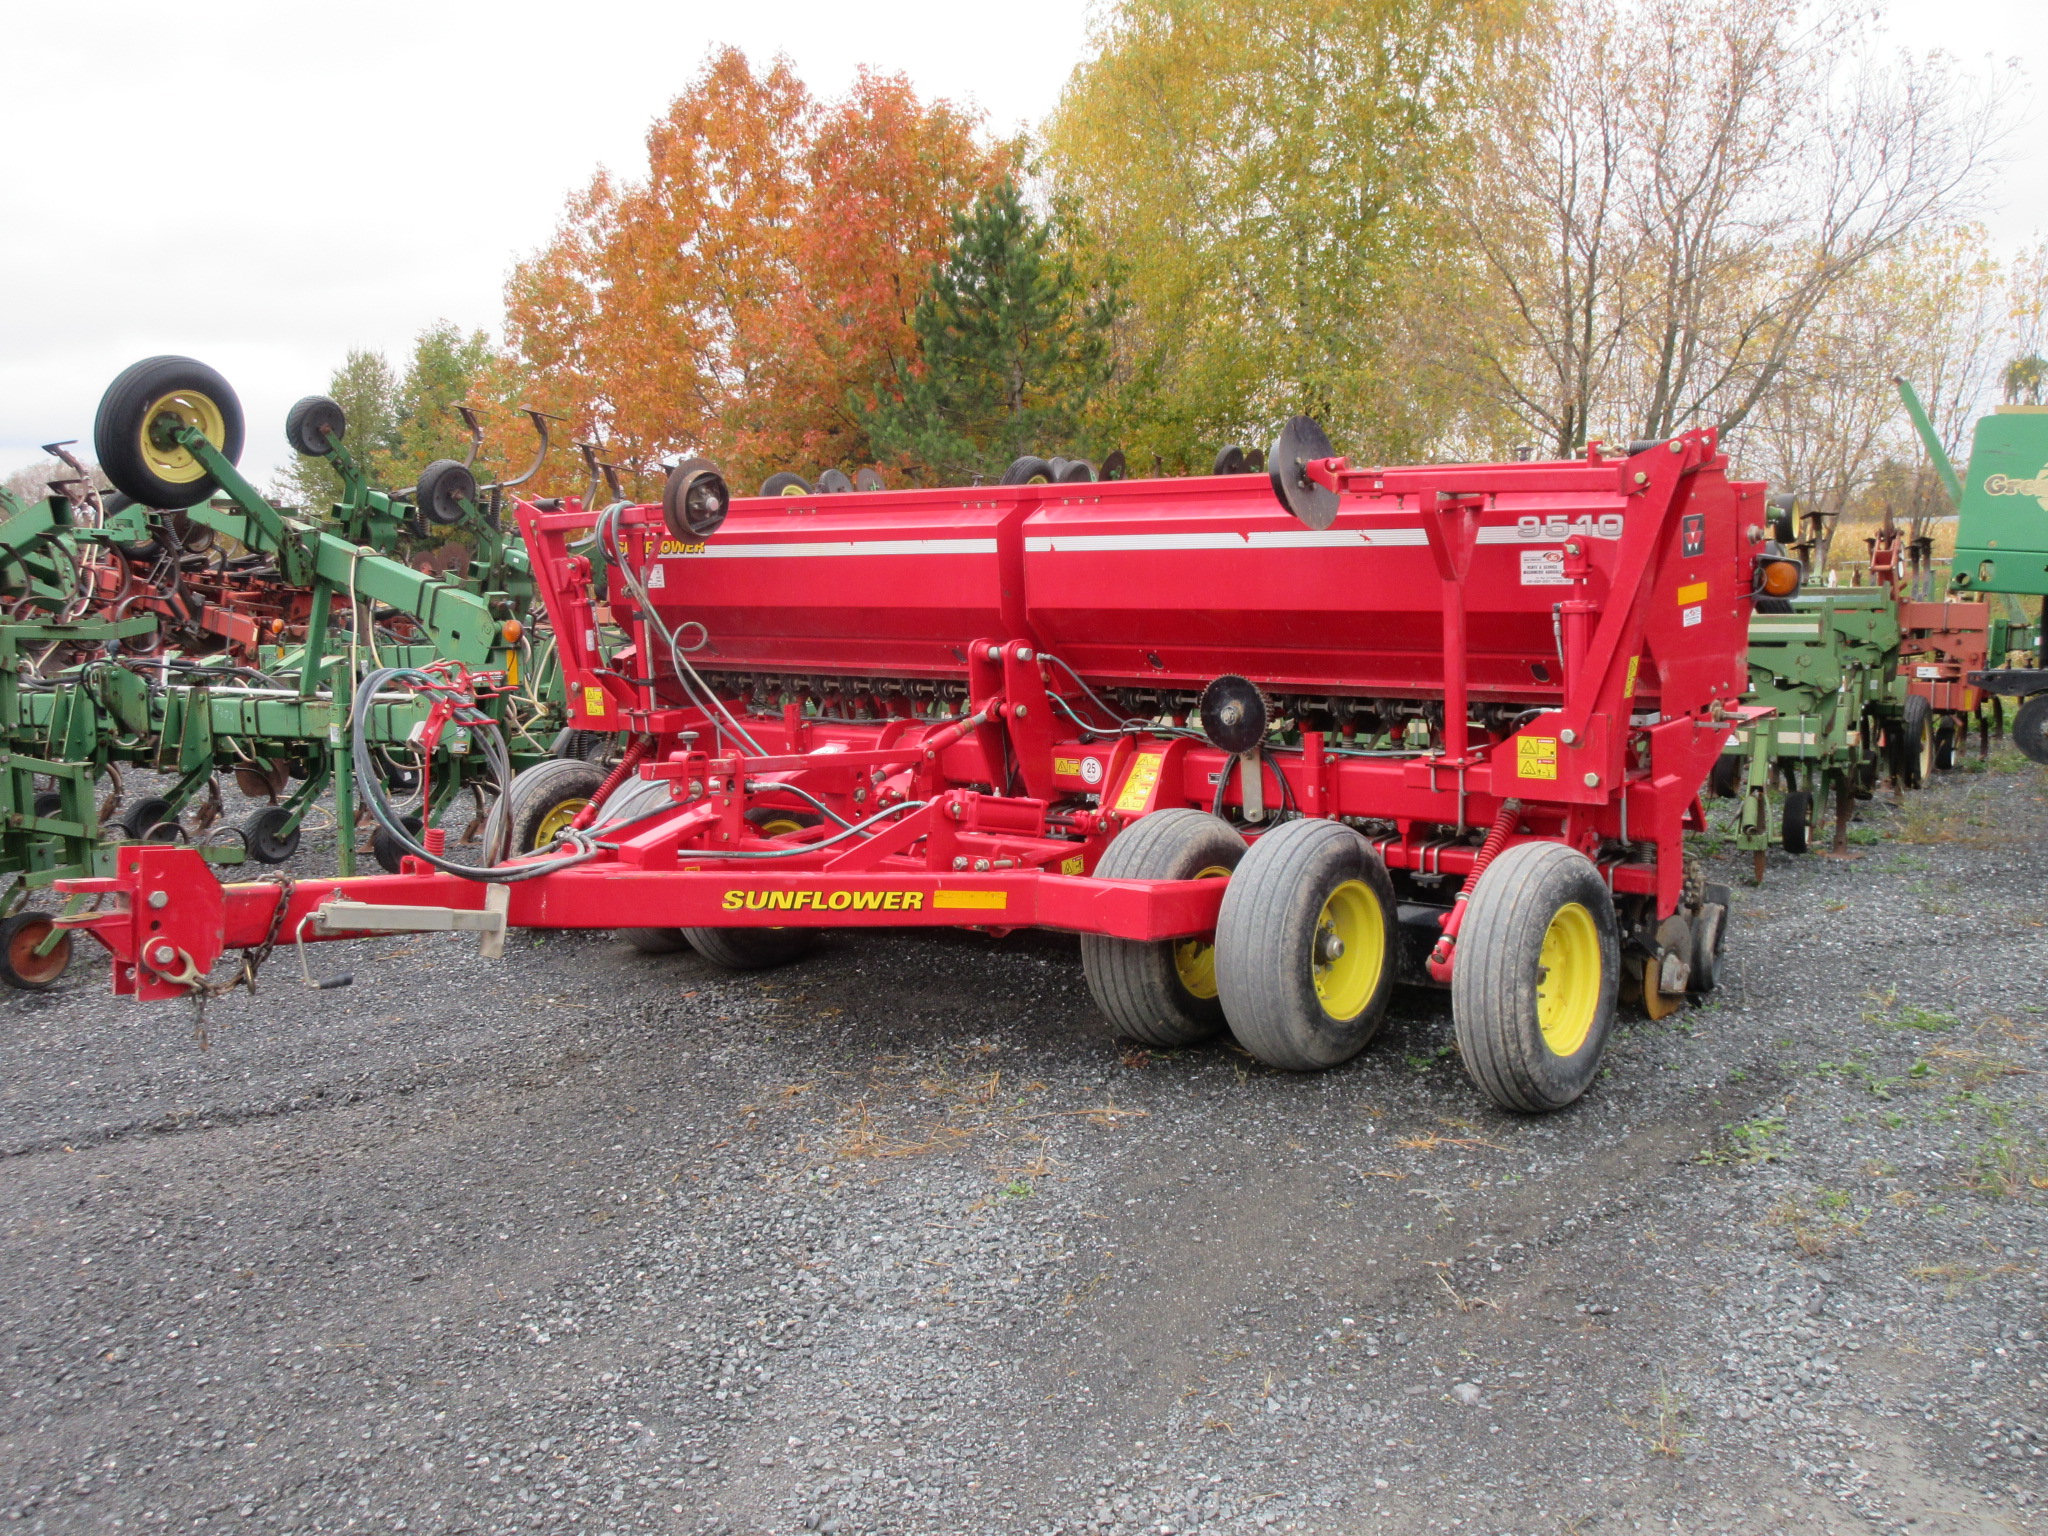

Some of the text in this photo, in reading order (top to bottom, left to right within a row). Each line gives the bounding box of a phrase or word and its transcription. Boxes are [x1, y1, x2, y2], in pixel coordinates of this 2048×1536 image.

[1518, 514, 1624, 537] 9510
[1087, 763, 1096, 773] 25
[722, 890, 924, 911] SUNFLOWER
